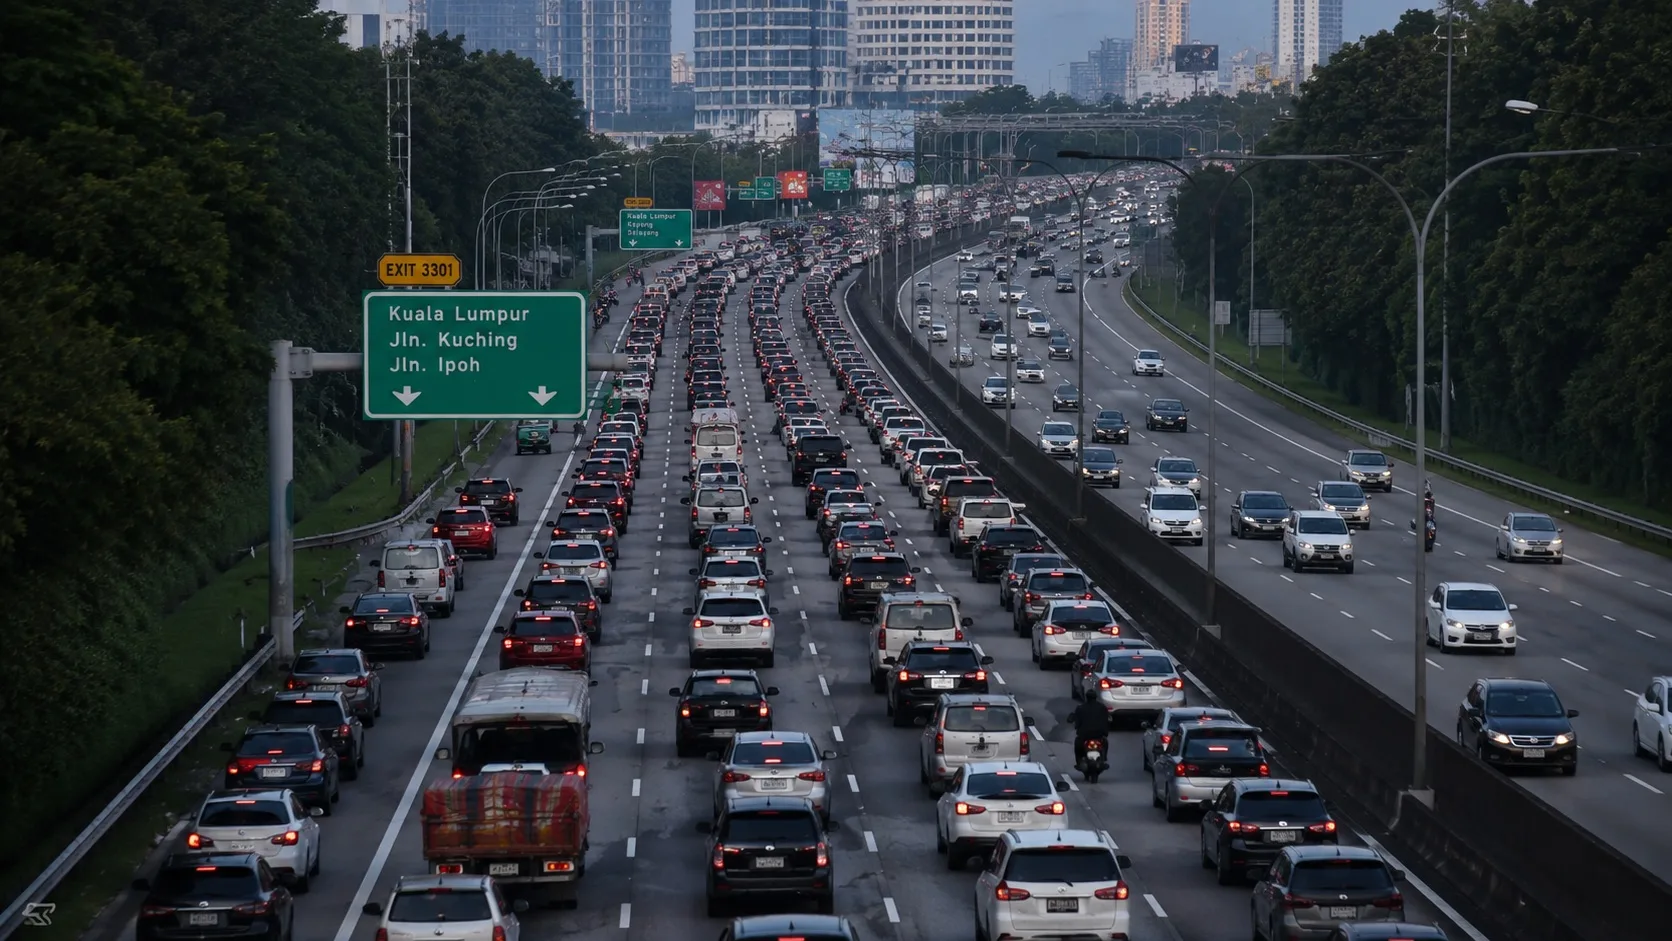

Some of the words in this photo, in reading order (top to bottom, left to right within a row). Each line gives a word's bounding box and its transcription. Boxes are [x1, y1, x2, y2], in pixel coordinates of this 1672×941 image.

[386, 263, 416, 276] EXIT
[422, 263, 453, 277] 3301
[389, 306, 444, 321] Kuala
[455, 306, 530, 325] Lumpur
[389, 332, 426, 347] Jln.
[438, 332, 518, 351] Kuching
[389, 357, 426, 372] Jln.
[438, 357, 480, 376] Ipoh
